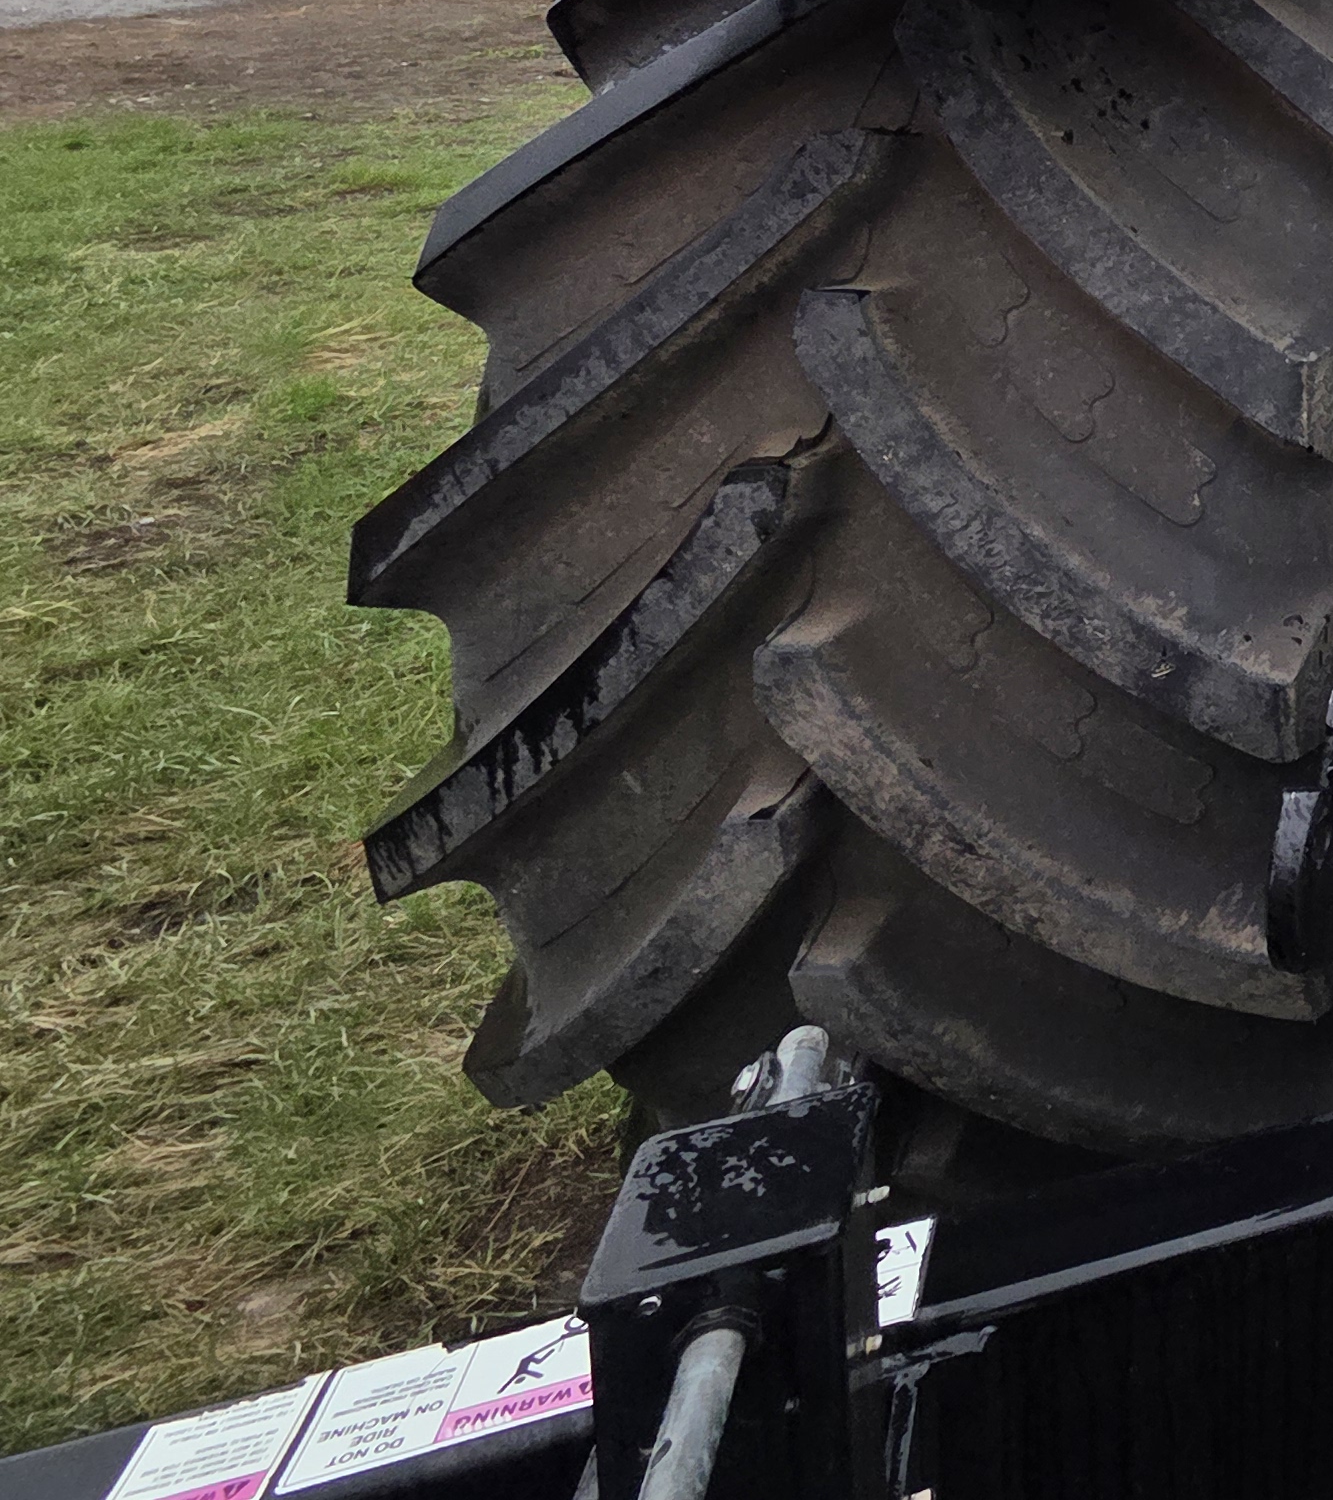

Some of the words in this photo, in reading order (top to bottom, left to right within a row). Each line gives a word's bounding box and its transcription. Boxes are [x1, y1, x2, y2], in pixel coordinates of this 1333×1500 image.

[415, 1399, 444, 1417] ON
[453, 1386, 572, 1431] WARNING
[316, 1408, 410, 1444] MACHINE
[349, 1425, 399, 1448] RIDE
[374, 1436, 406, 1454] DO
[324, 1448, 371, 1469] NOT
